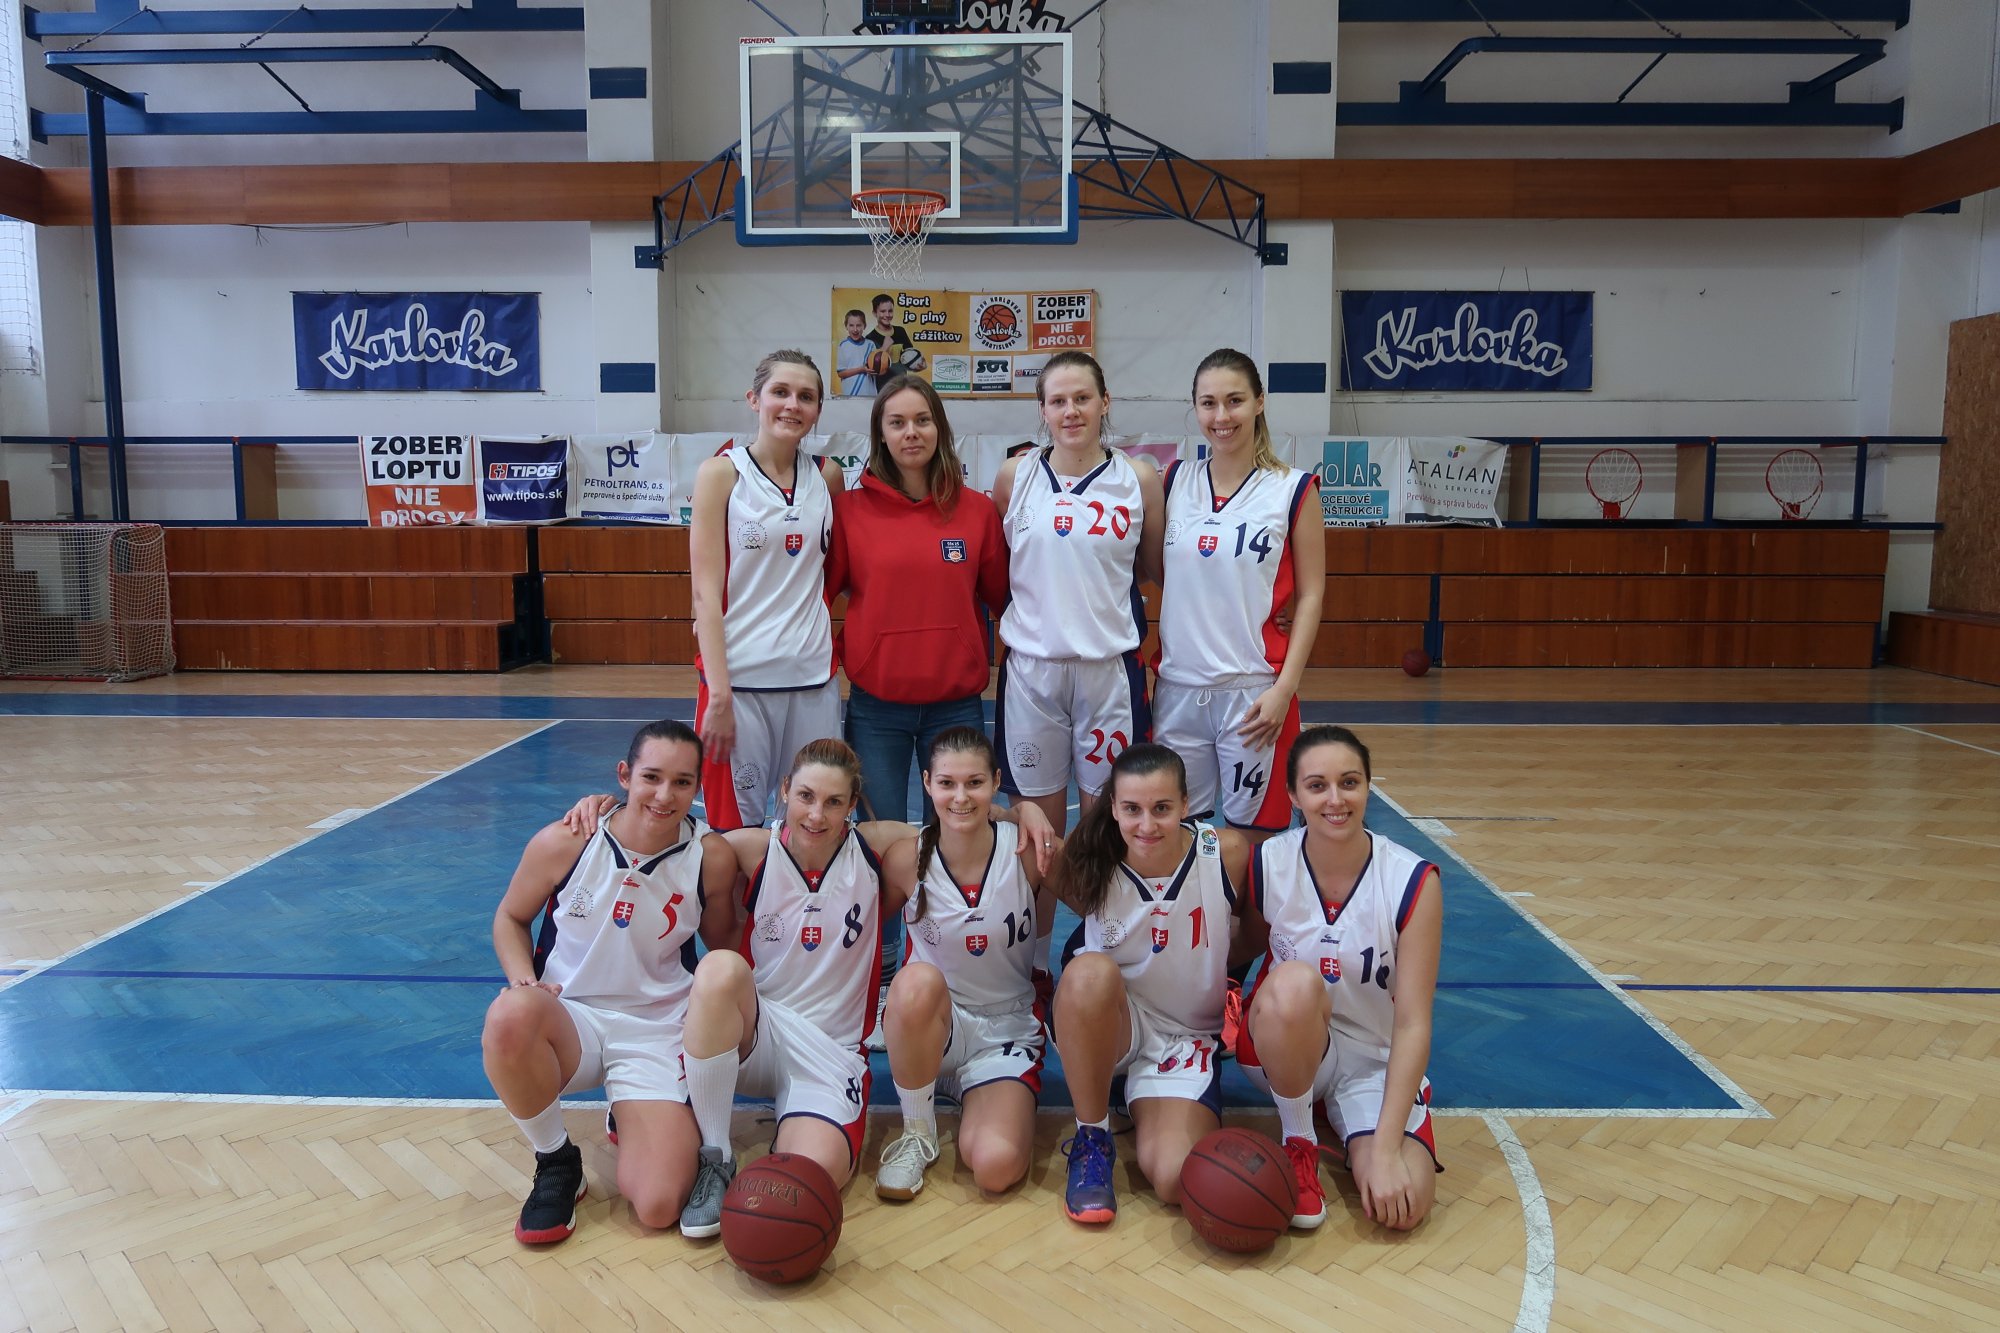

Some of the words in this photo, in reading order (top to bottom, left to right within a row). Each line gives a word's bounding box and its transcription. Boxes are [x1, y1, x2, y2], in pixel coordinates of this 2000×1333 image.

[898, 293, 930, 307] Šport
[1037, 296, 1086, 308] ZOBER
[903, 311, 917, 324] je
[920, 311, 946, 324] plný
[1037, 308, 1085, 321] LOPTU
[913, 330, 962, 343] zážitkov
[974, 322, 1022, 340] Karlovka
[1050, 323, 1074, 334] NIE
[319, 303, 518, 379] Karlovka
[1038, 335, 1086, 346] DROGY
[1363, 302, 1568, 380] Karlovka
[371, 436, 463, 455] ZOBER
[606, 440, 639, 477] pt
[372, 460, 461, 479] LOPTU
[510, 464, 557, 477] TIPOS
[1407, 459, 1496, 484] ATALIAN
[584, 478, 650, 491] PETROLTRANS,
[651, 482, 665, 490] a.s.
[1445, 485, 1492, 495] SERVICES
[394, 487, 441, 506] NIE
[486, 489, 563, 503] www.tipos.sk
[583, 491, 615, 501] prepravné
[1443, 498, 1465, 509] správa
[1466, 500, 1488, 510] budov
[380, 509, 466, 527] DROGY
[1322, 504, 1384, 515] NŠTRUKCIE
[1087, 500, 1132, 541] 20
[1234, 522, 1273, 565] 14
[1085, 728, 1128, 765] 20
[1233, 761, 1265, 799] 14
[1202, 844, 1216, 852] FIBA
[658, 892, 684, 940] 5
[842, 902, 863, 949] 8
[1188, 906, 1205, 950] 1
